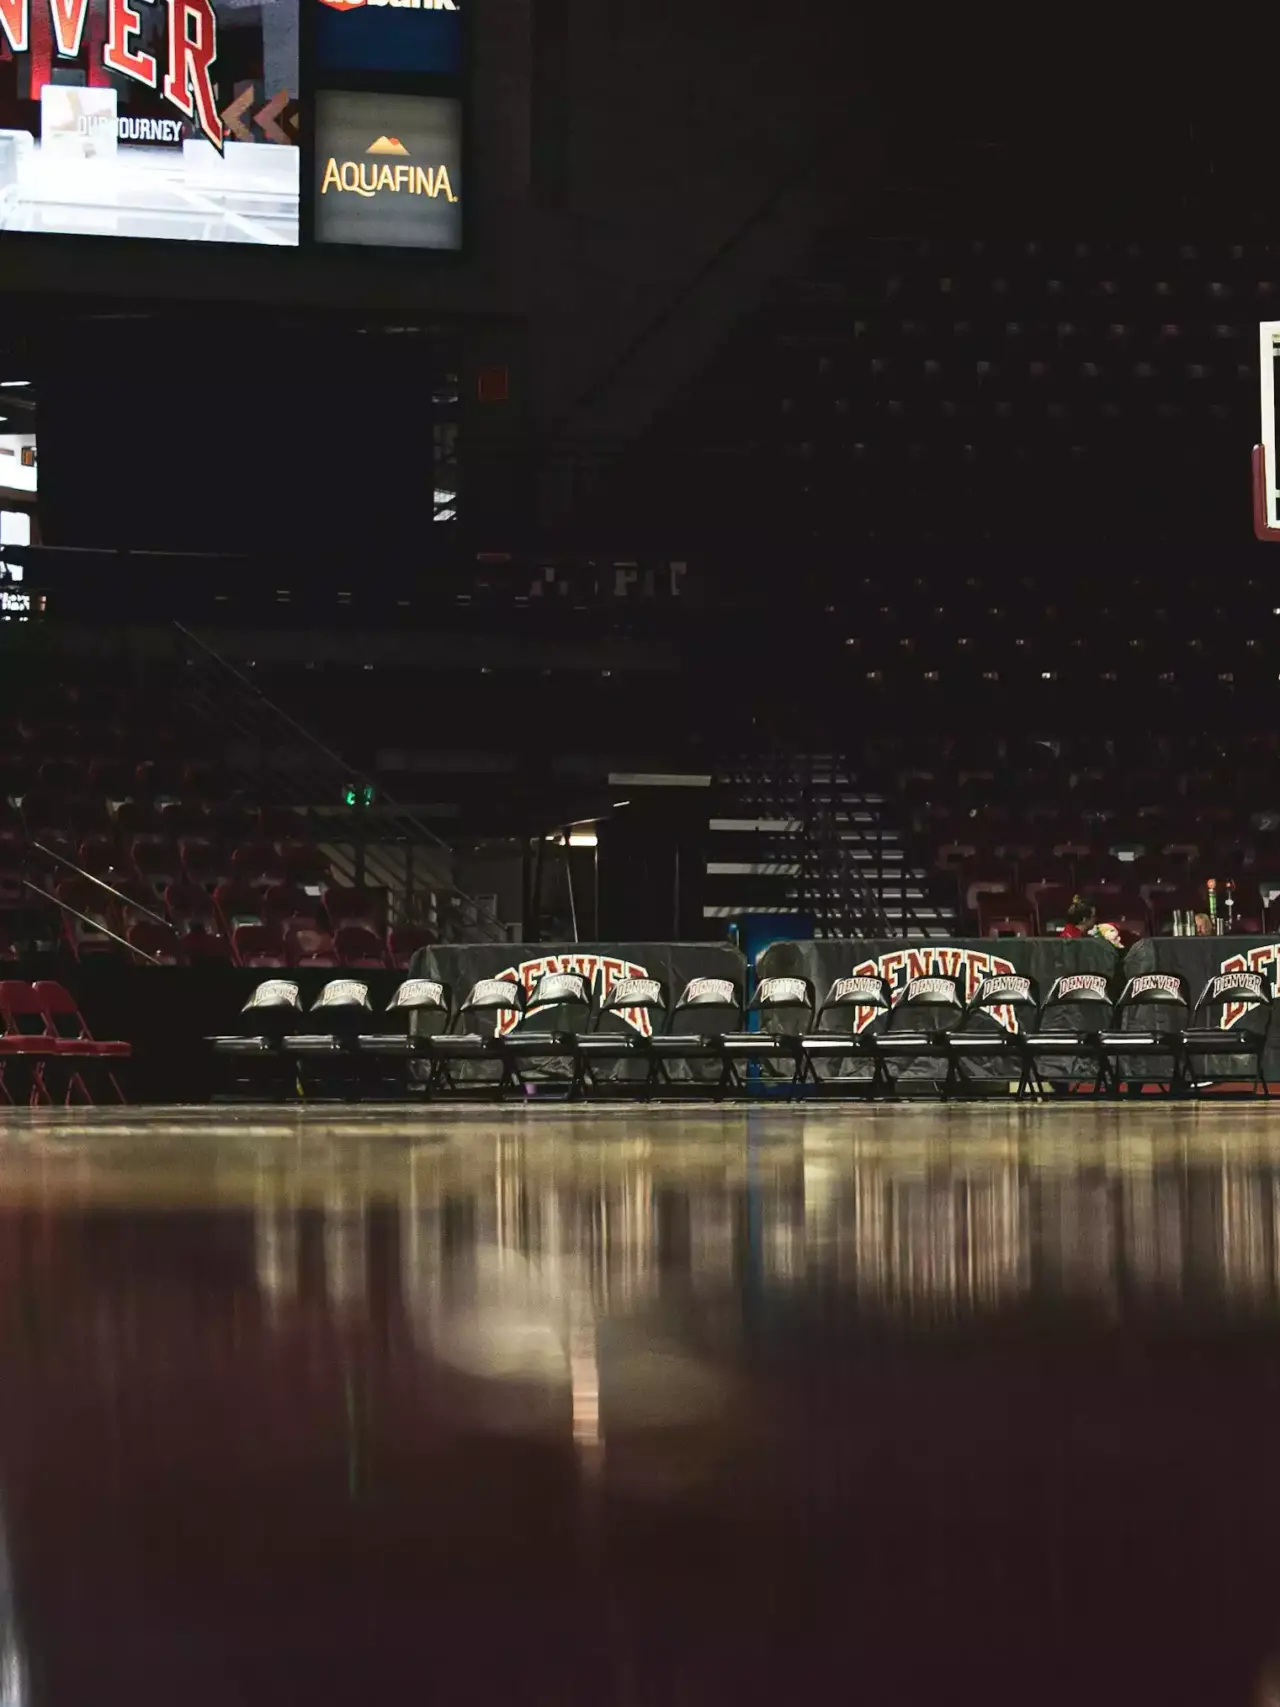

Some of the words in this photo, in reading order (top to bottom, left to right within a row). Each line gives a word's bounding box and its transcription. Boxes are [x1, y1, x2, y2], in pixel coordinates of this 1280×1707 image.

[79, 115, 107, 136] OU
[116, 117, 182, 141] OURNEY
[321, 157, 456, 202] AQUAFINA
[1058, 975, 1106, 998] DENVER
[1131, 975, 1180, 998] DENVER
[1213, 974, 1262, 997] DENVER
